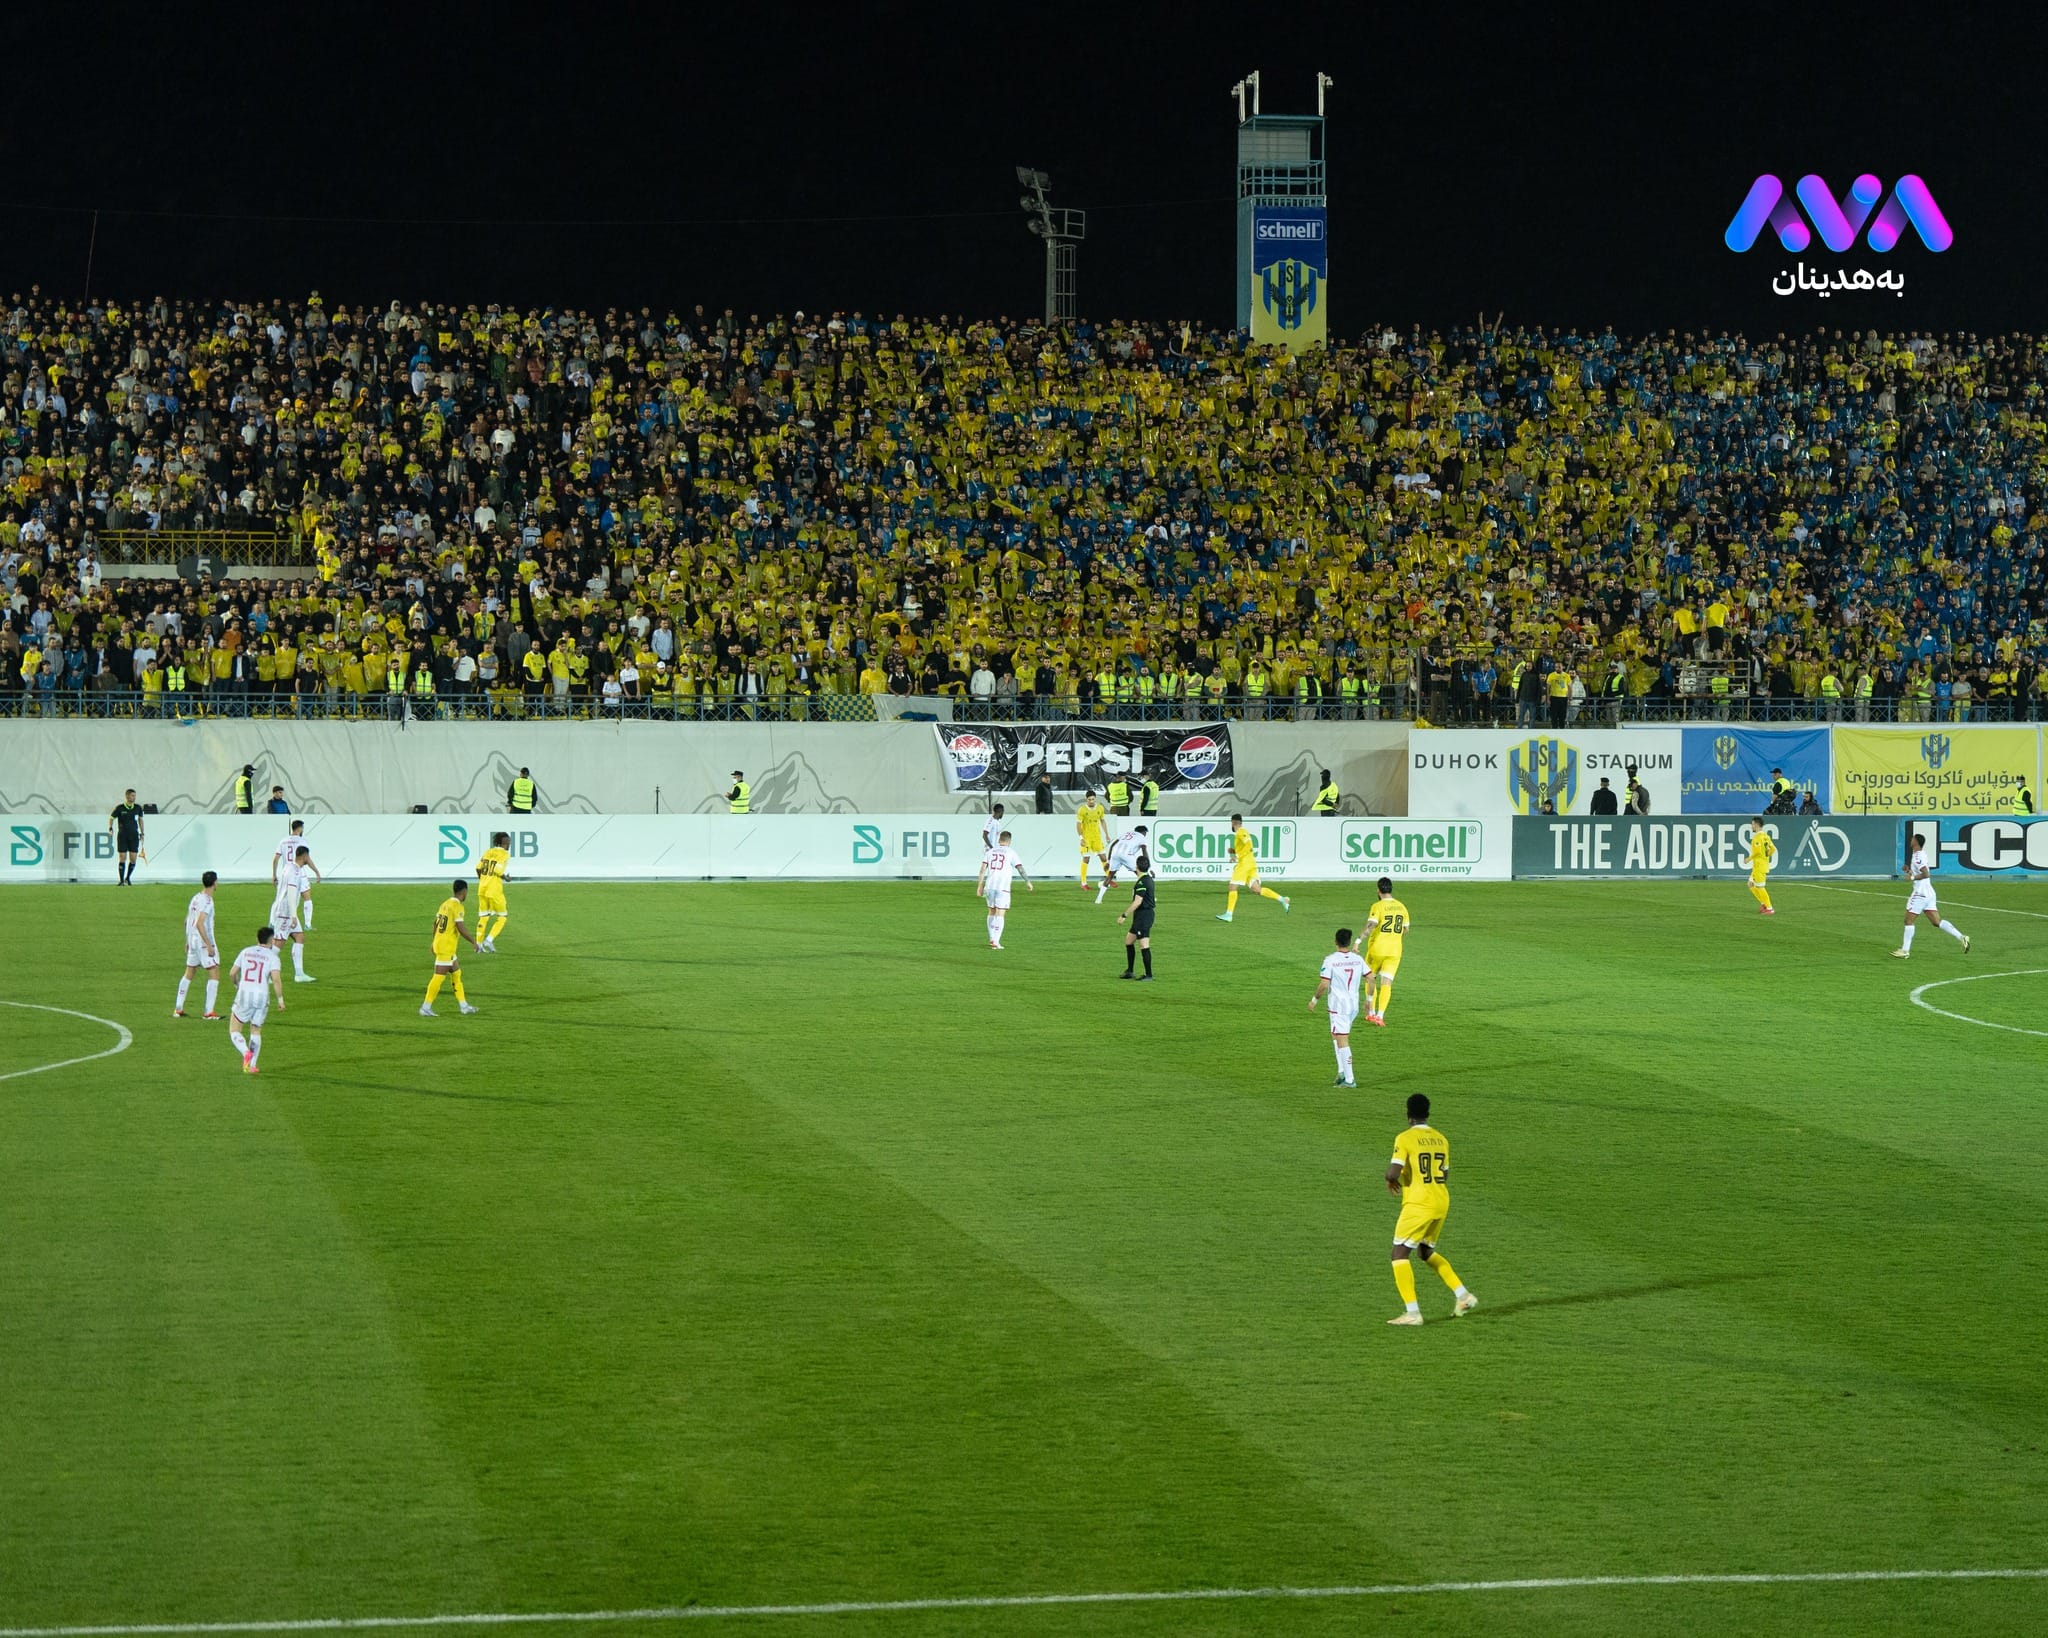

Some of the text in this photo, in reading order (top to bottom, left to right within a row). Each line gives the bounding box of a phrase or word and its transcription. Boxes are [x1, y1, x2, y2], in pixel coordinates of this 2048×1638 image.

[196, 559, 212, 580] 5
[1017, 743, 1143, 774] PEPSI
[1177, 752, 1217, 763] PEPSI
[1414, 754, 1673, 769] DUHOK STADIUM
[63, 832, 115, 859] FIB
[902, 831, 950, 857] FIB
[1549, 823, 1612, 870] THE
[990, 853, 1005, 871] 23
[1162, 864, 1202, 874] Motors
[1206, 864, 1222, 874] Oil
[1349, 864, 1390, 873] Motors
[1393, 864, 1409, 873] Oil
[1420, 864, 1472, 875] Germany
[1380, 914, 1404, 934] 28
[244, 959, 265, 984] 21
[1344, 968, 1354, 991] 7
[1418, 1152, 1446, 1184] 93
